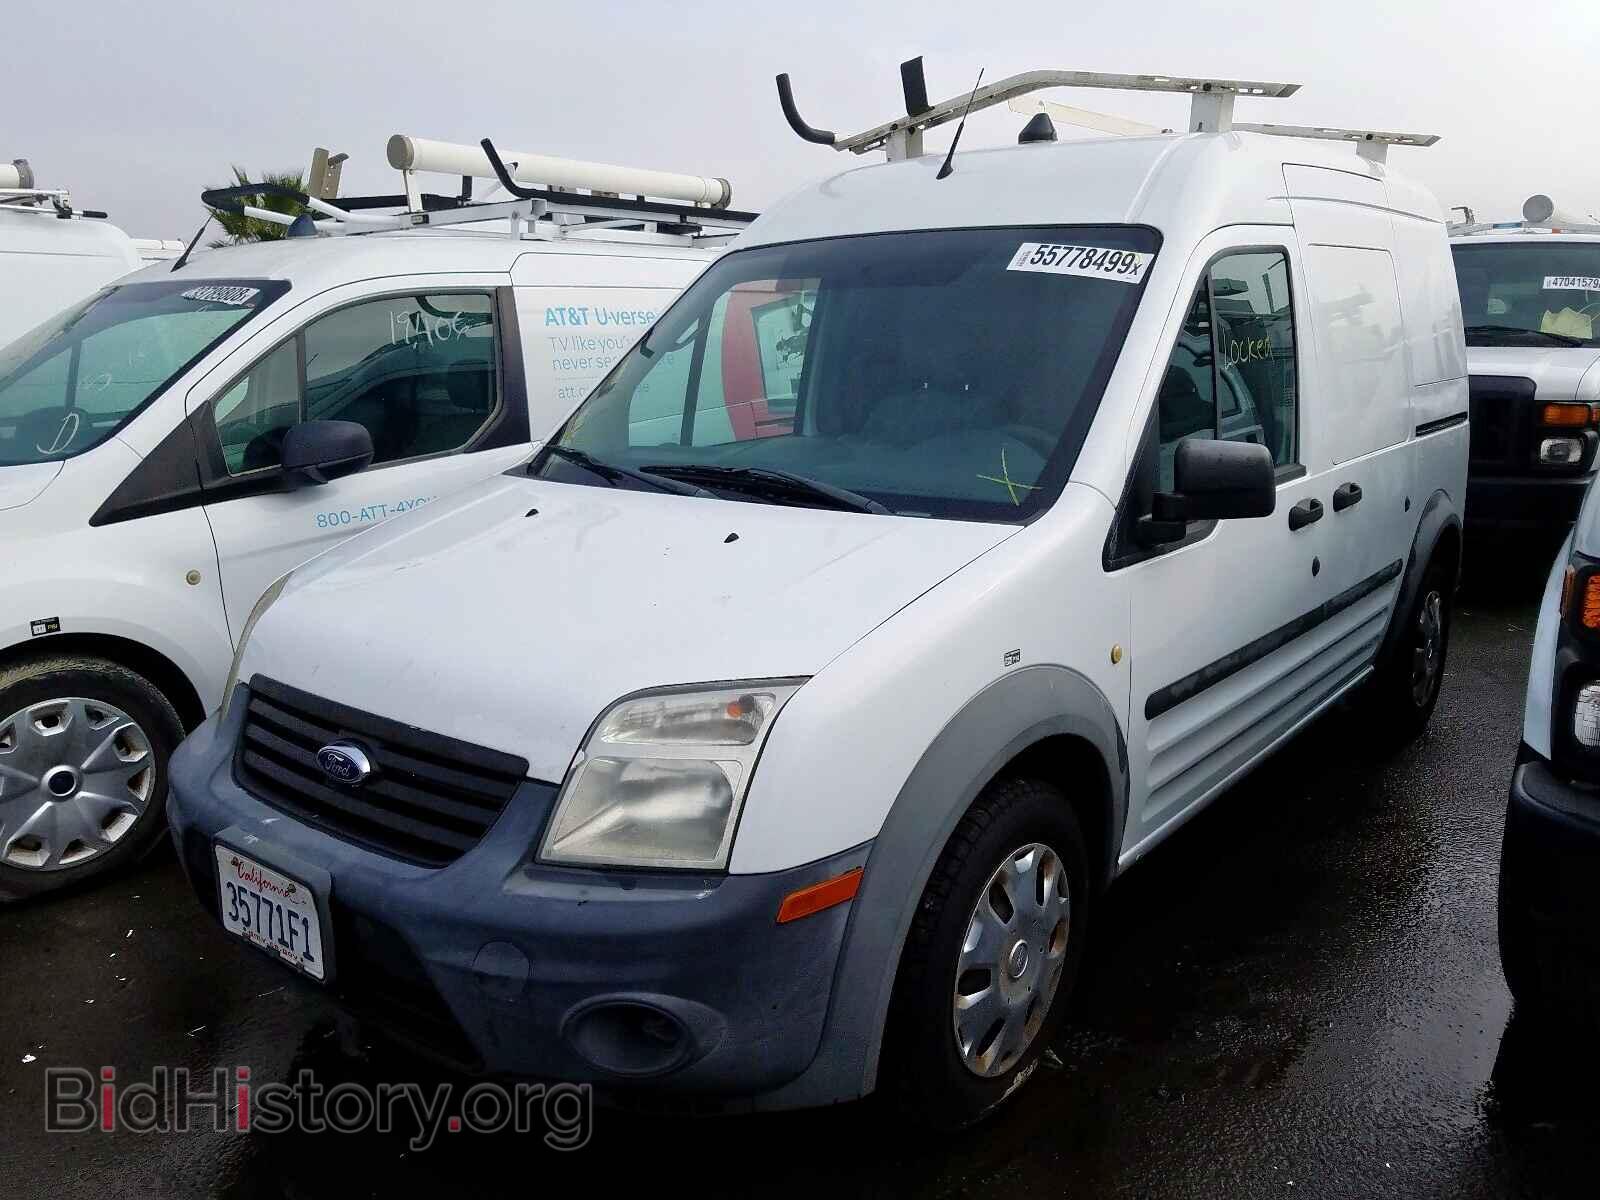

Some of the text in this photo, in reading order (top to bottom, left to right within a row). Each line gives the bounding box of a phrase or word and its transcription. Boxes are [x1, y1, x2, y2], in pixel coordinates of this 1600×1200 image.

[545, 307, 588, 326] AT&T
[549, 336, 571, 353] TV
[571, 335, 596, 351] like
[552, 356, 592, 371] never
[226, 881, 315, 962] 35771F1
